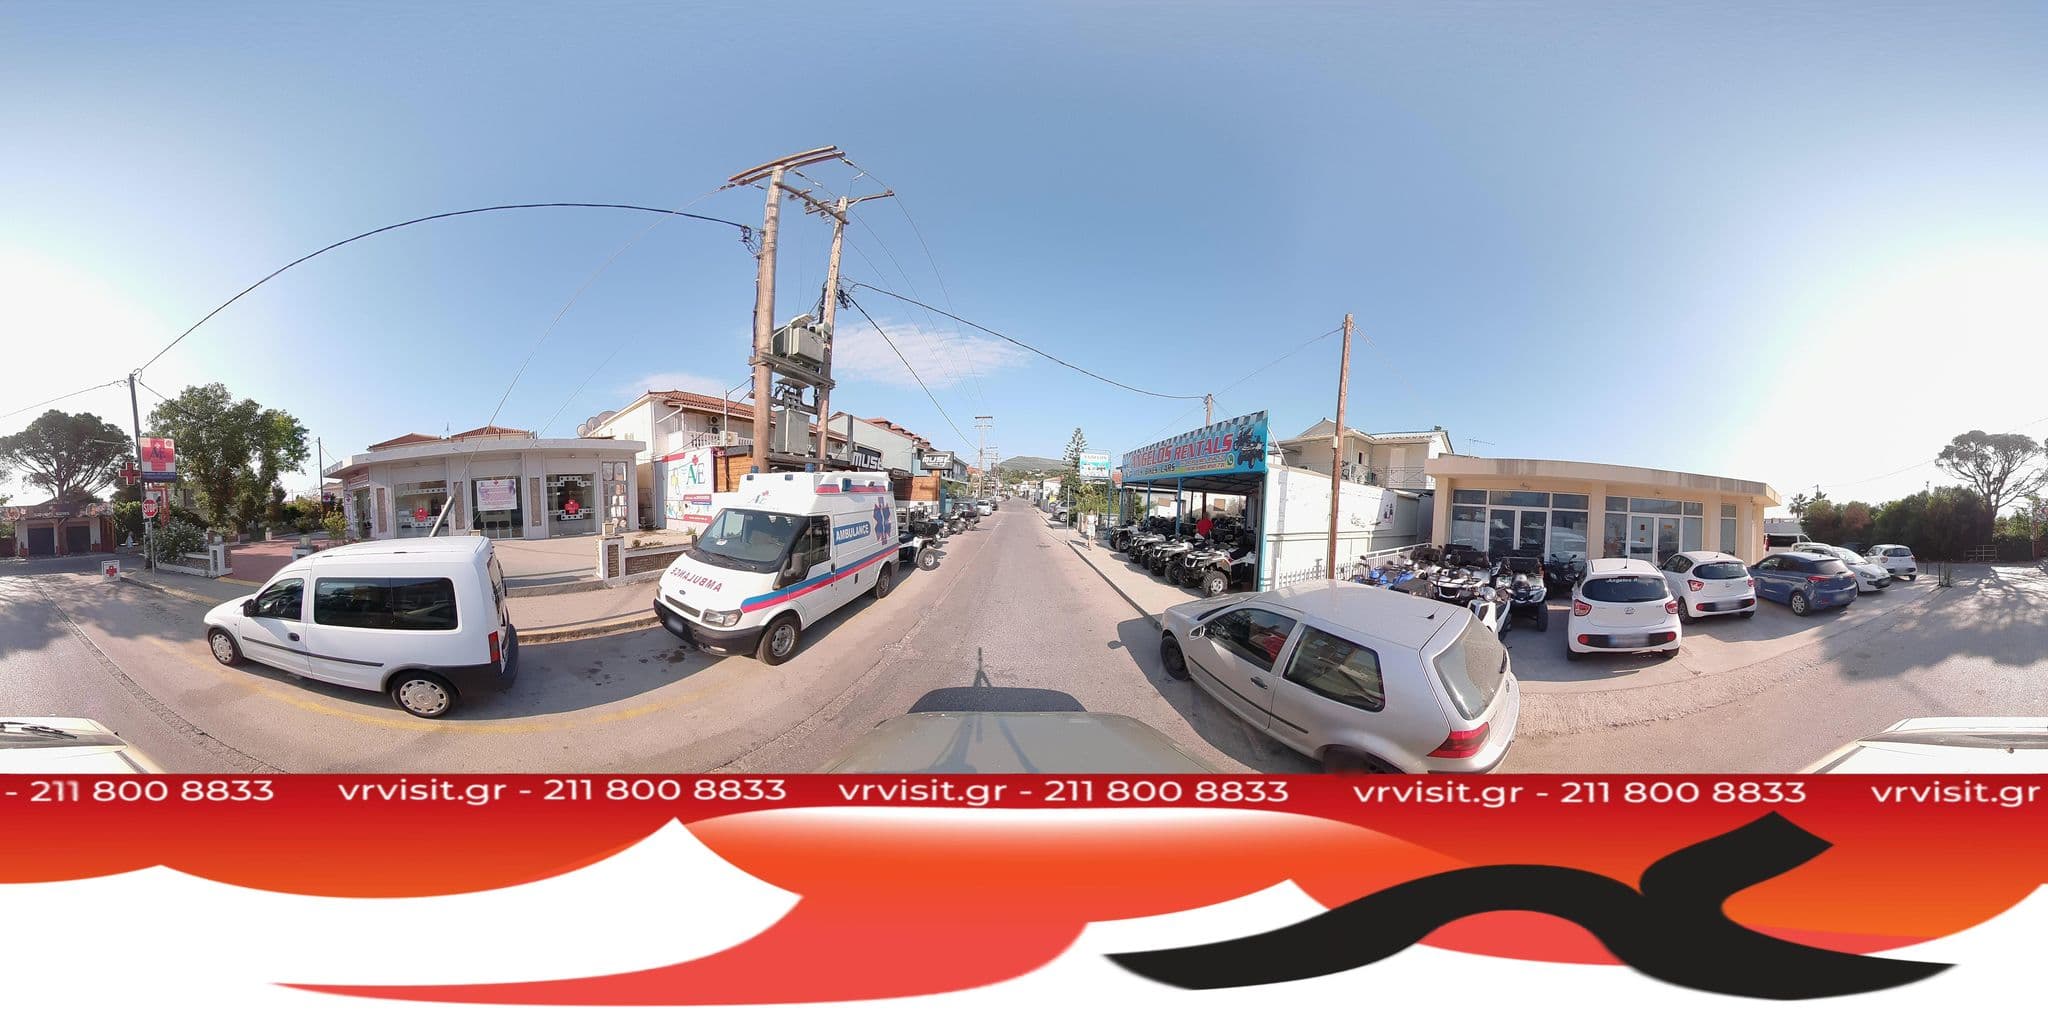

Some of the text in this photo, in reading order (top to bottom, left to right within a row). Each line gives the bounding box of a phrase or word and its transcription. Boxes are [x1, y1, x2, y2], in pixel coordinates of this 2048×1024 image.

[1132, 445, 1173, 468] ANGELOS
[1174, 433, 1234, 460] RENTALS
[143, 503, 156, 513] STOP
[836, 523, 869, 541] AMBULANCE
